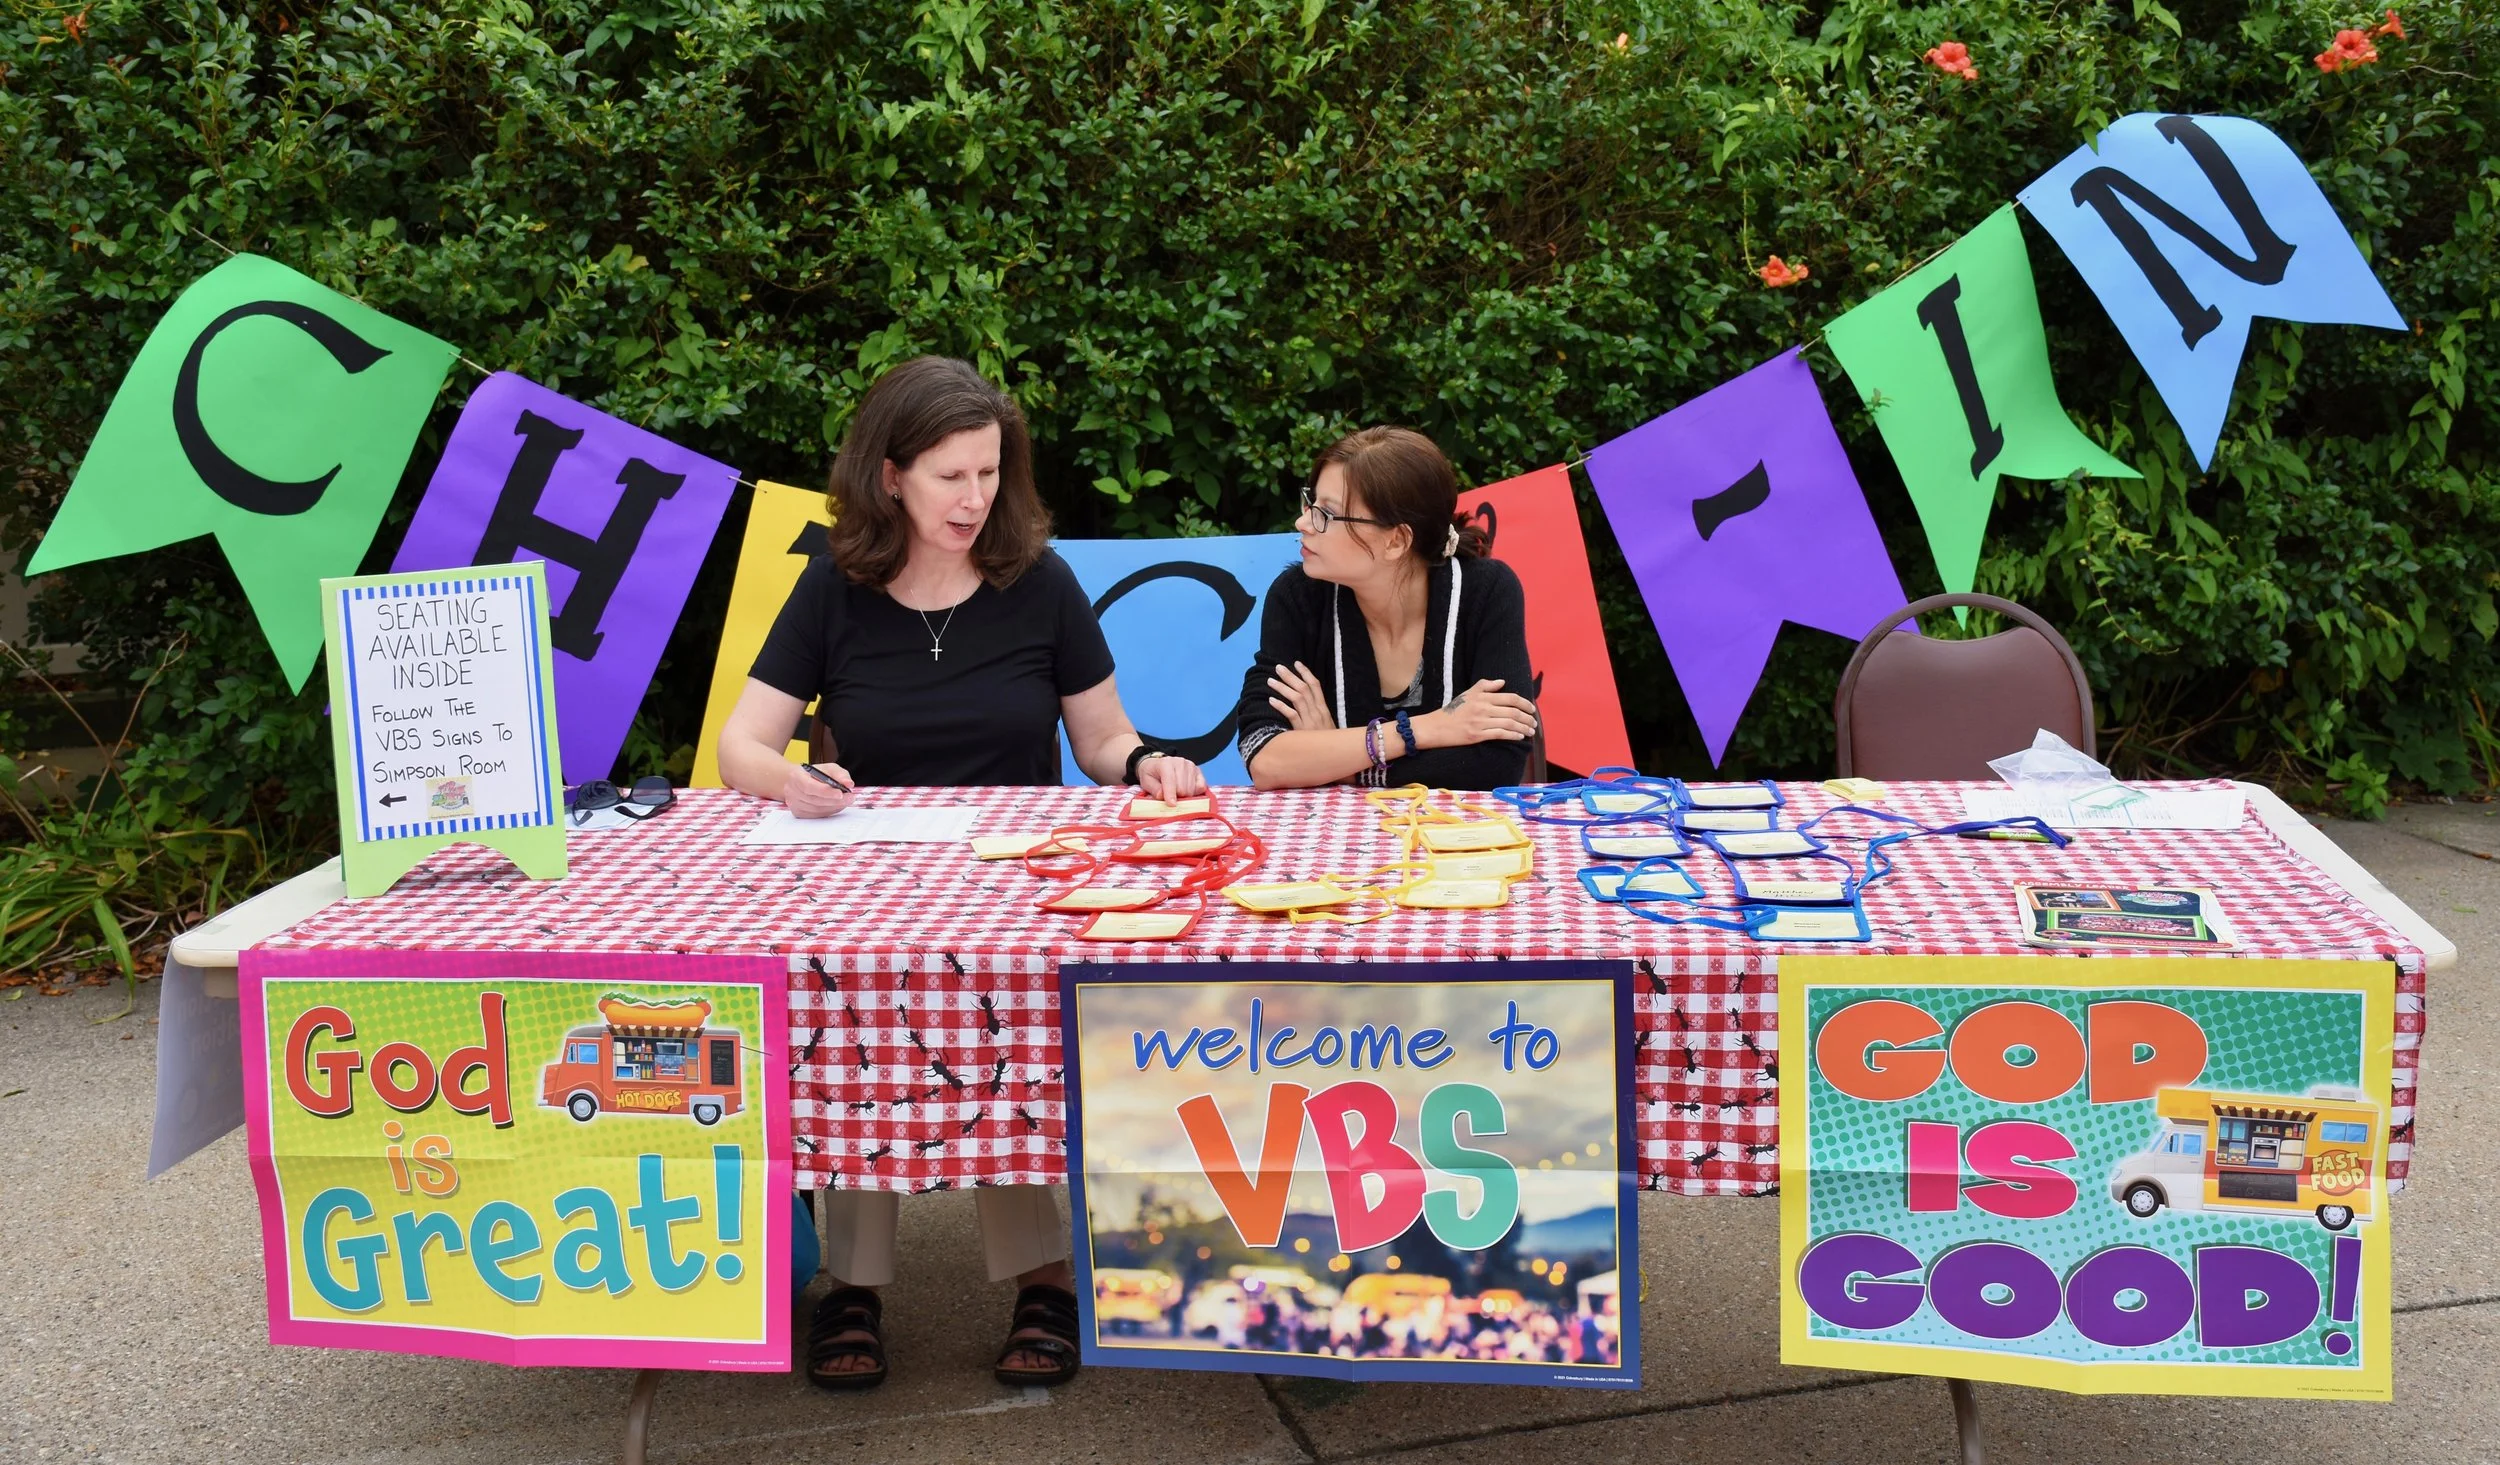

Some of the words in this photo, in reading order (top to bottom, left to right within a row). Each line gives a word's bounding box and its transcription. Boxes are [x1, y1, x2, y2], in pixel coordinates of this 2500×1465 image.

[377, 597, 487, 631] SEATING
[369, 625, 507, 661] AVAILABLE
[393, 659, 473, 690] INSIDE
[444, 698, 476, 717] THE
[376, 728, 422, 751] VBS
[285, 992, 514, 1126] God
[1132, 997, 1455, 1074] welcome
[1488, 1000, 1560, 1072] to
[1816, 999, 2208, 1105] GOD
[615, 1091, 640, 1109] HOT
[644, 1090, 682, 1108] DOGS
[382, 1120, 460, 1196] is
[1176, 1080, 1520, 1253] VBS
[1907, 1121, 2078, 1220] IS
[2311, 1167, 2365, 1192] FOOD
[2312, 1150, 2359, 1171] FAST
[302, 1144, 744, 1312] Great!
[1798, 1233, 2362, 1356] GOOD!
